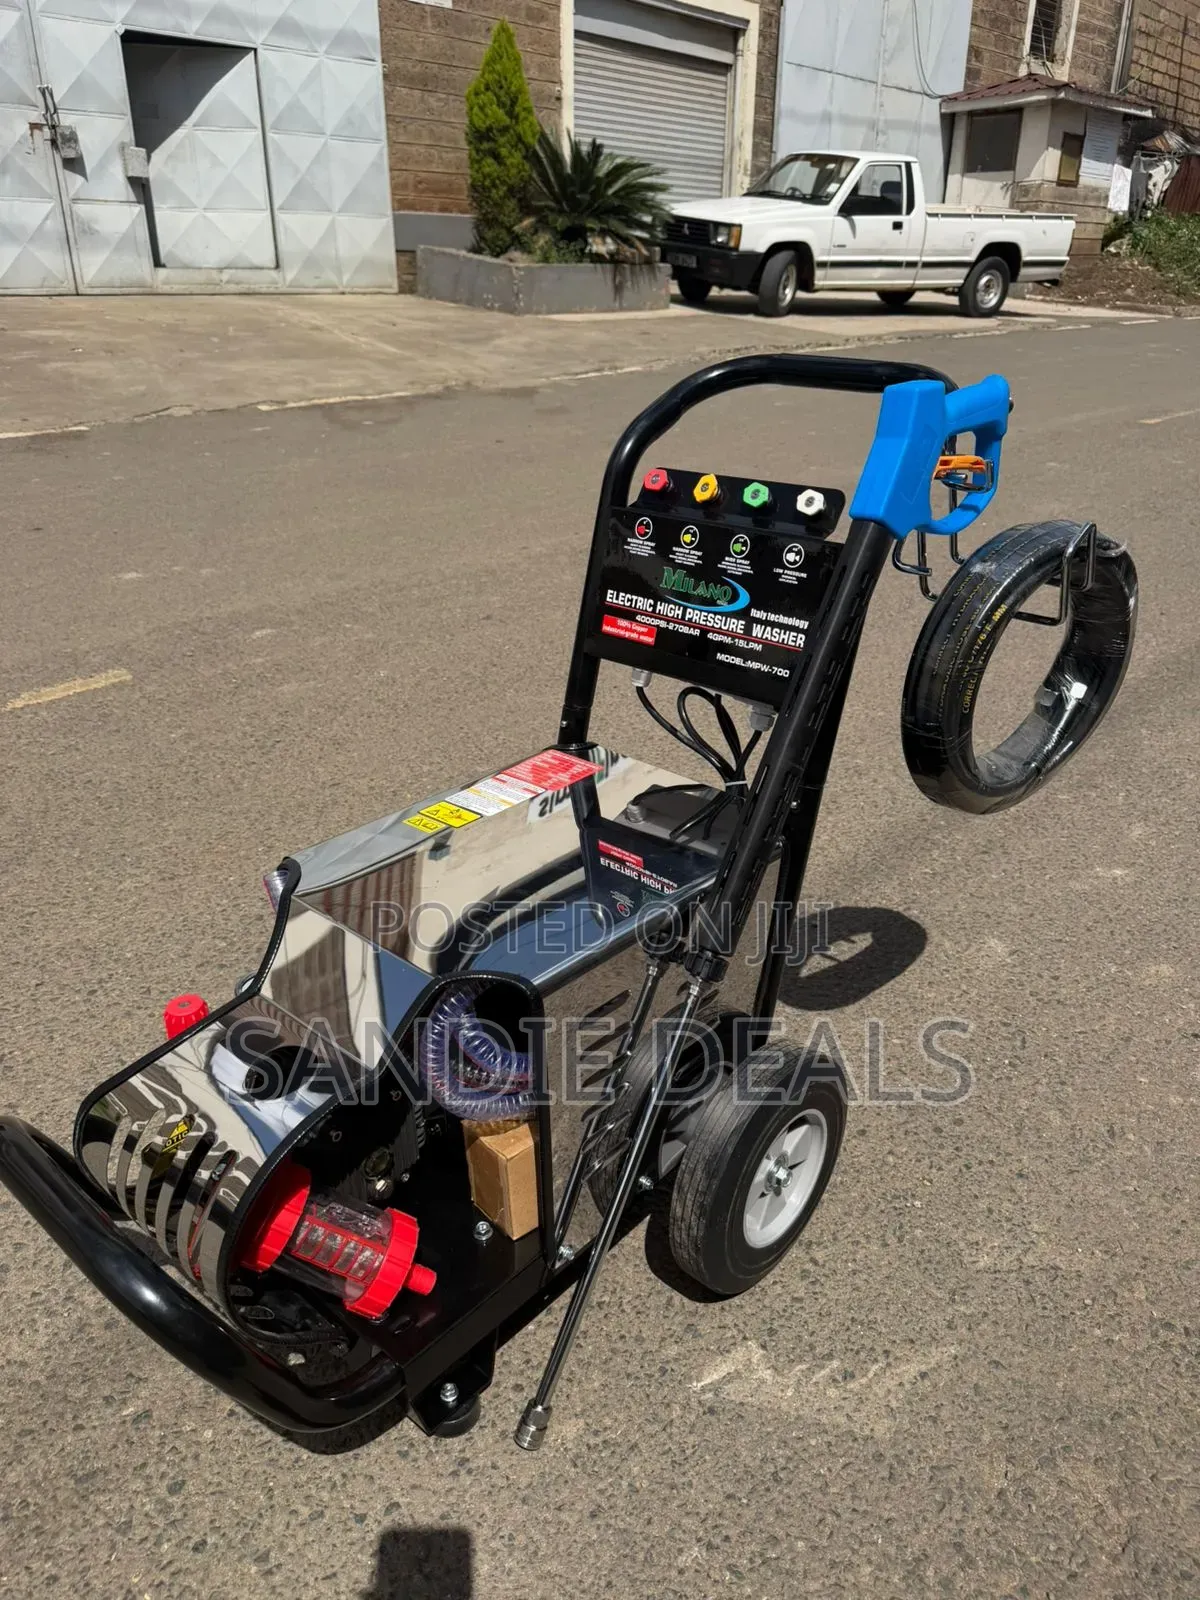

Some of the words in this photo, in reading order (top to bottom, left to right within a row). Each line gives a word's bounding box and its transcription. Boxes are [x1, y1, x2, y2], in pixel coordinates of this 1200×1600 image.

[773, 567, 784, 575] LOW
[606, 589, 654, 612] ELECTRIC
[655, 601, 684, 620] HIGH
[684, 608, 746, 634] PRESSURE
[751, 623, 807, 648] WASHER
[750, 608, 768, 621] Italy
[767, 611, 810, 630] technology
[635, 614, 701, 637] 4000PSI-270BAR
[706, 632, 763, 653] 4GPM-15LPM
[166, 1130, 188, 1147] OTIC
